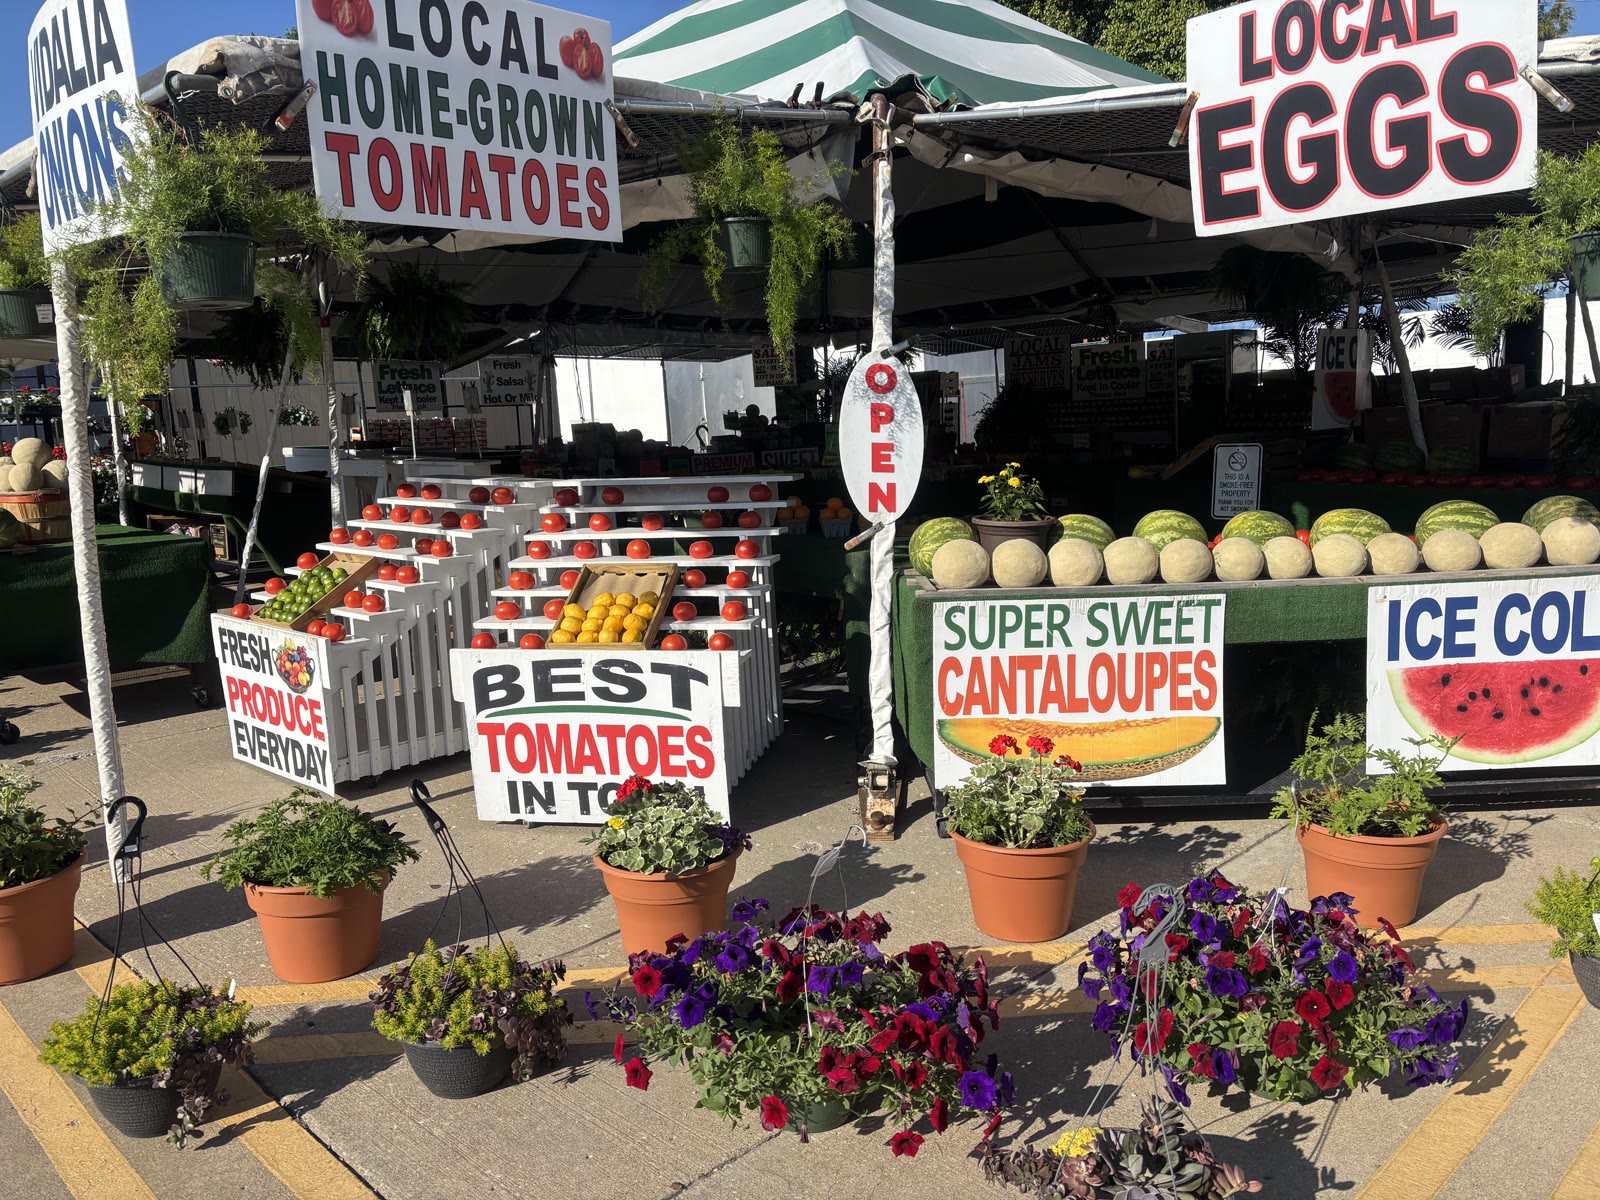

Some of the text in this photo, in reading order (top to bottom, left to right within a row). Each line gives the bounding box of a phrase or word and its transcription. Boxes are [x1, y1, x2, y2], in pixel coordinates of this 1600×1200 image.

[30, 0, 123, 122] VIDALIA
[386, 0, 559, 80] LOCAL
[1239, 0, 1458, 86] LOCAL
[316, 51, 605, 160] HOME-GROWN
[1196, 41, 1522, 225] EGGS
[39, 90, 134, 229] ONIONS
[325, 132, 610, 231] TOMATOES
[493, 360, 521, 370] Fresh
[1010, 337, 1064, 354] LOCAL
[1013, 355, 1062, 368] JAMS
[1080, 345, 1138, 366] Fresh
[1321, 335, 1345, 370] ICE
[379, 364, 433, 380] Fresh
[496, 377, 524, 387] Salsa
[1077, 366, 1141, 381] Lettuce
[1077, 382, 1097, 392] Kept
[1110, 380, 1141, 390] Cooler
[378, 395, 399, 405] Kept
[484, 394, 503, 404] Hot
[504, 393, 517, 403] Or
[694, 453, 752, 471] PREMIUM
[865, 363, 897, 513] OPEN
[1218, 481, 1255, 489] SMOKE-FREE
[944, 598, 1221, 651] SUPER SWEET
[1387, 596, 1478, 662] ICE
[218, 627, 274, 677] FRESH
[473, 657, 709, 716] BEST
[937, 649, 1217, 717] CANTALOUPES
[227, 676, 326, 742] PRODUCE
[235, 719, 328, 788] EVERYDAY
[476, 721, 716, 778] TOMATOES
[507, 780, 557, 815] IN
